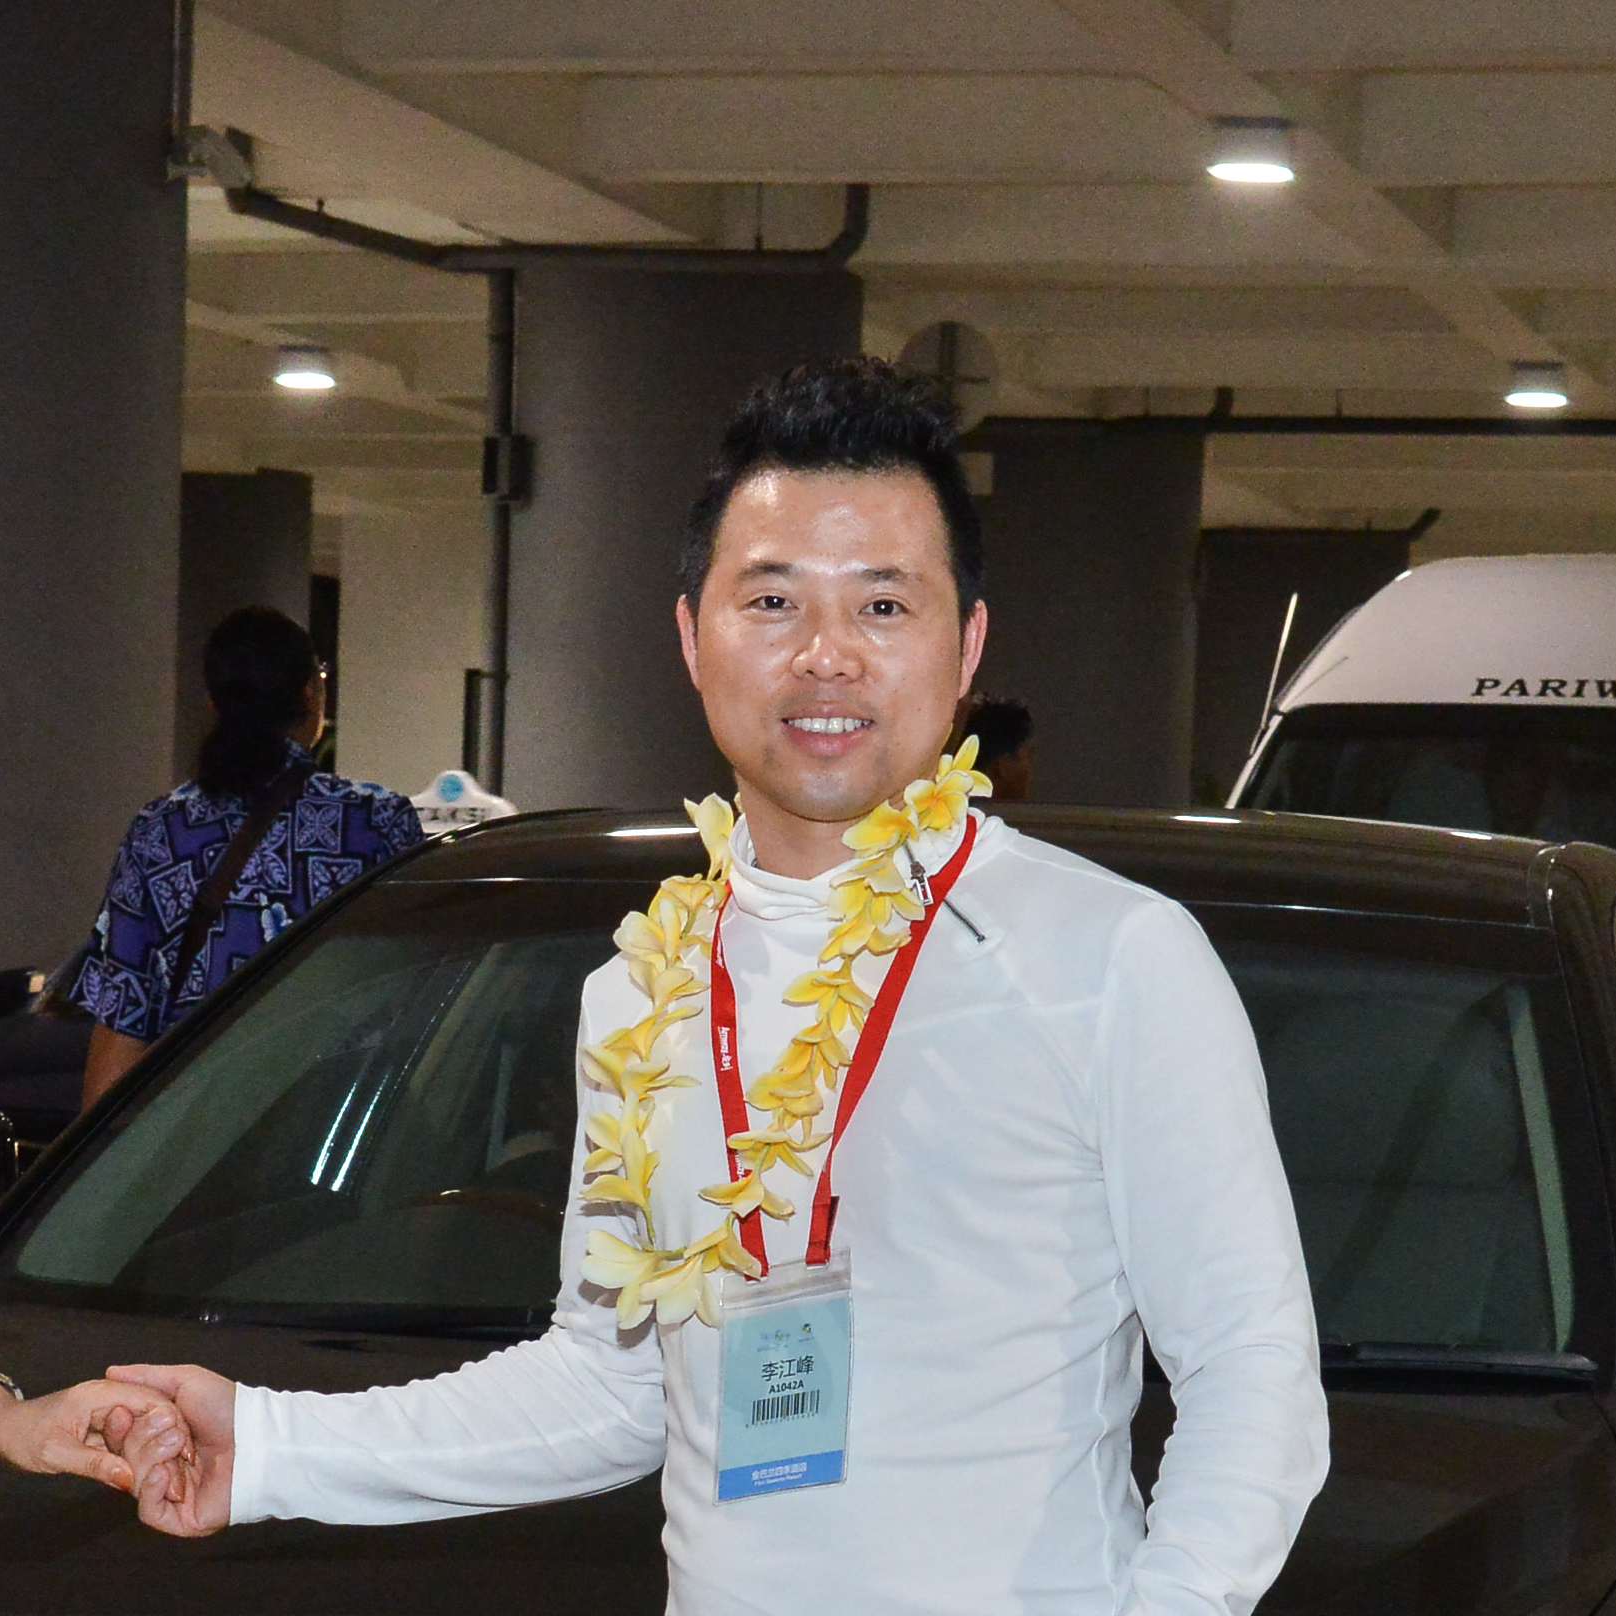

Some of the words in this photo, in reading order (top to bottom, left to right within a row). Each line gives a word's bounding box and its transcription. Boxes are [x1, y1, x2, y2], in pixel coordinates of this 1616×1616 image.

[762, 1355, 814, 1381] 李江峰
[769, 1379, 804, 1394] A1042A
